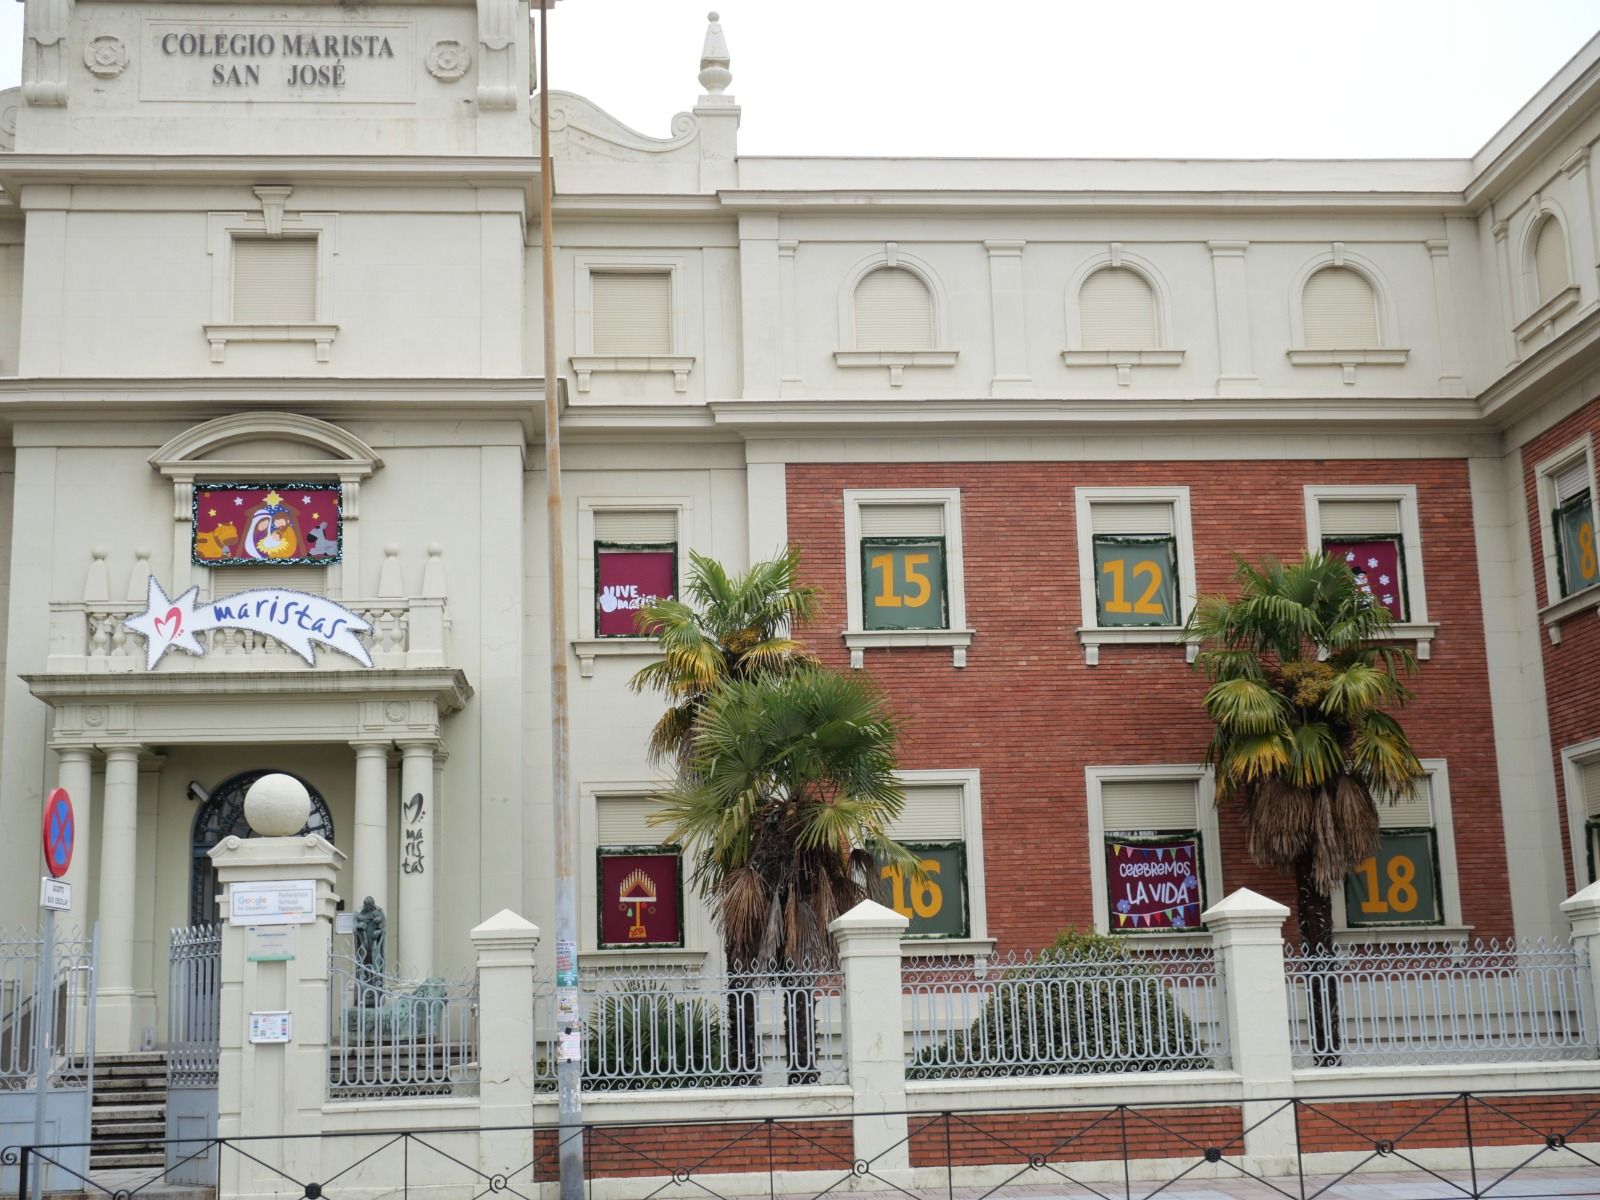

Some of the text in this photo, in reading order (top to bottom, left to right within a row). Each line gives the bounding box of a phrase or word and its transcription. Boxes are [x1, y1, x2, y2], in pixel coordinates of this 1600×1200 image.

[161, 33, 394, 58] COLEGIO MARISTA
[212, 58, 346, 87] SAN JOSÉ
[1578, 521, 1597, 580] 8
[871, 553, 932, 608] 15
[1102, 559, 1164, 615] 12
[213, 595, 347, 640] maristas
[237, 896, 268, 906] Google
[880, 858, 943, 919] 16
[1126, 881, 1189, 905] LA VIDA
[1354, 855, 1418, 913] 18
